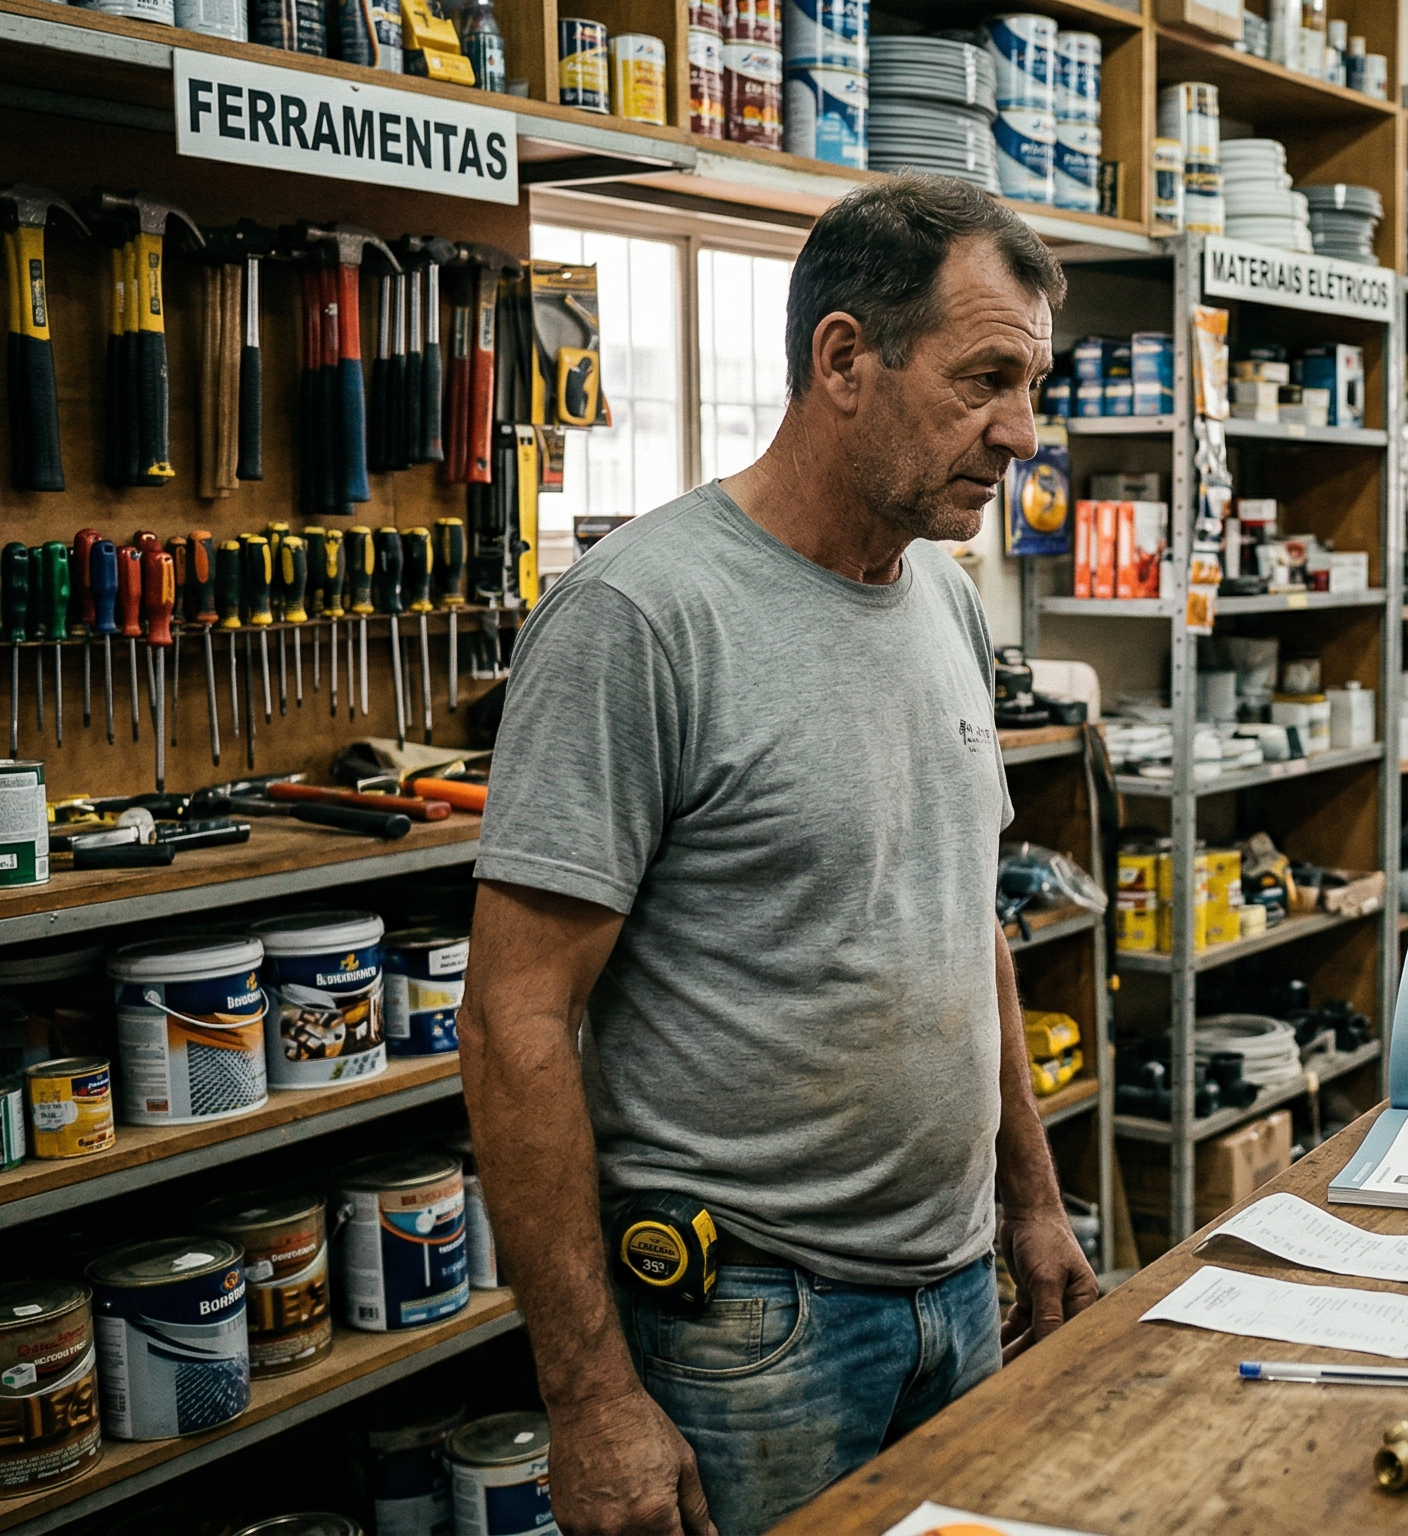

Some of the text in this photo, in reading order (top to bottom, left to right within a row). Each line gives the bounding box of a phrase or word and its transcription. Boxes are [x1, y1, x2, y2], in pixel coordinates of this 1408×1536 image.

[188, 77, 508, 181] FERRAMENTAS
[1212, 251, 1388, 309] MATERIAIS ELÉTRICOS
